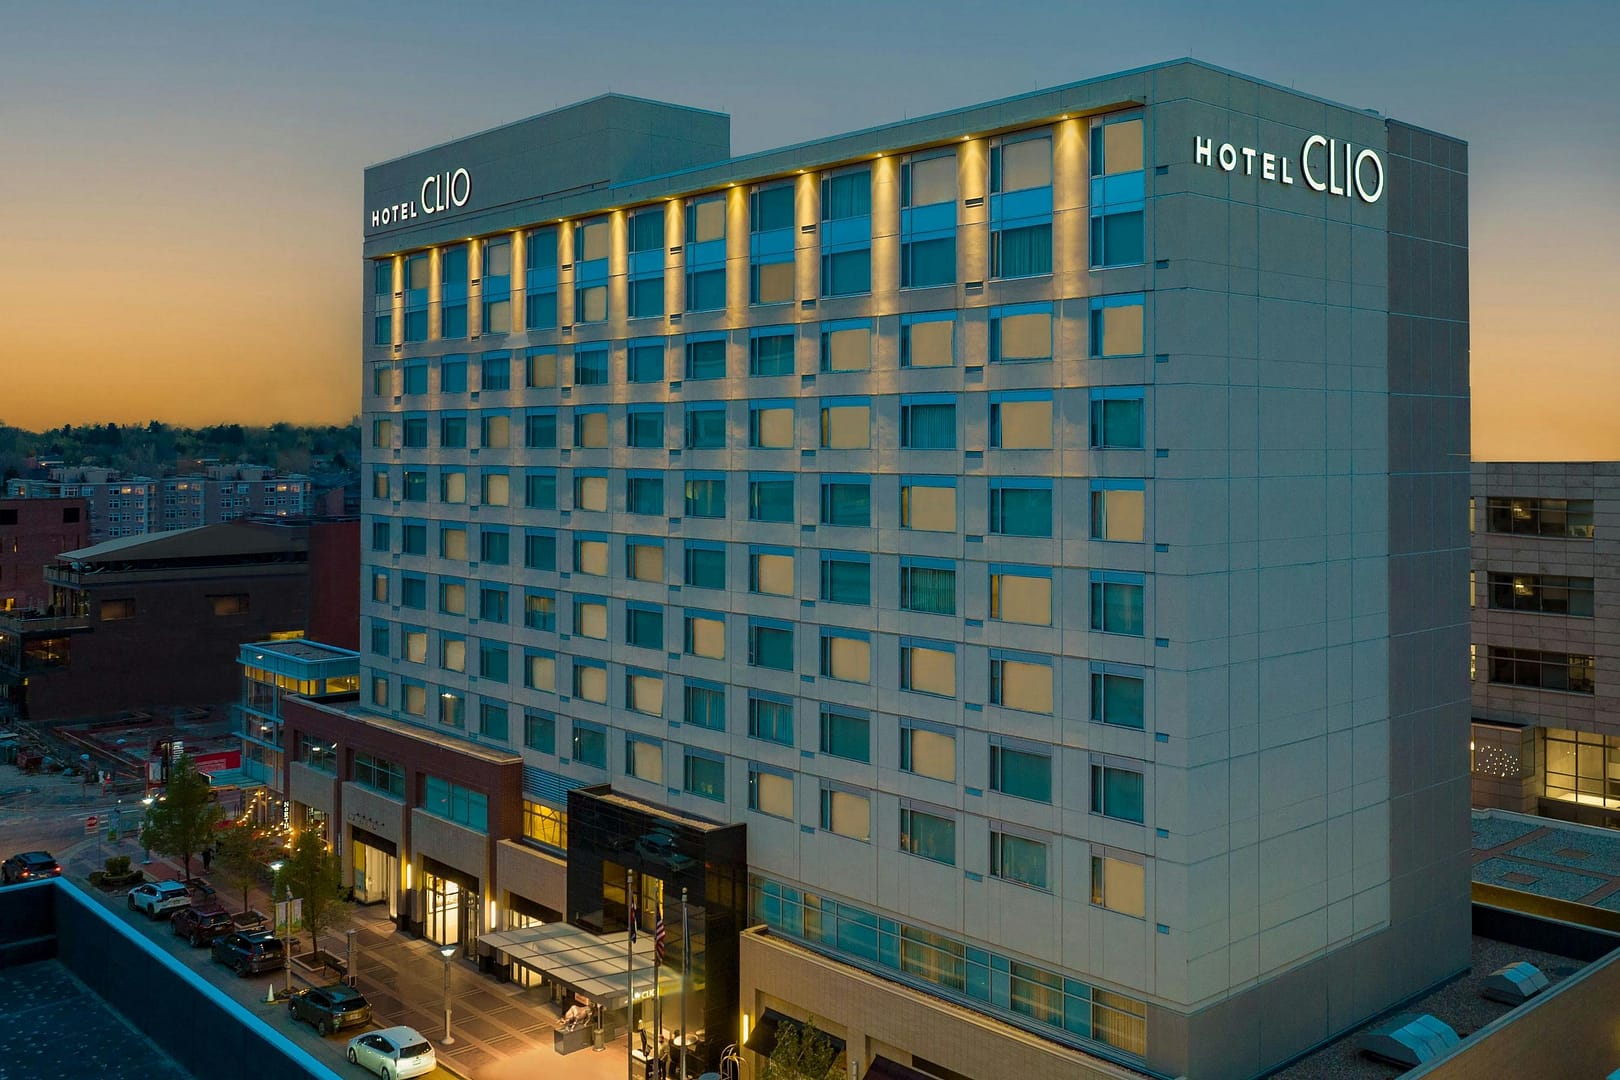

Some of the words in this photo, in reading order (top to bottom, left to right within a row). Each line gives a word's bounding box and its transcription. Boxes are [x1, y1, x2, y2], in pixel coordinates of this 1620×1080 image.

[371, 200, 418, 228] HOTEL
[421, 167, 471, 214] CLIO
[1194, 135, 1294, 185] HOTEL
[1302, 134, 1384, 204] CLIO
